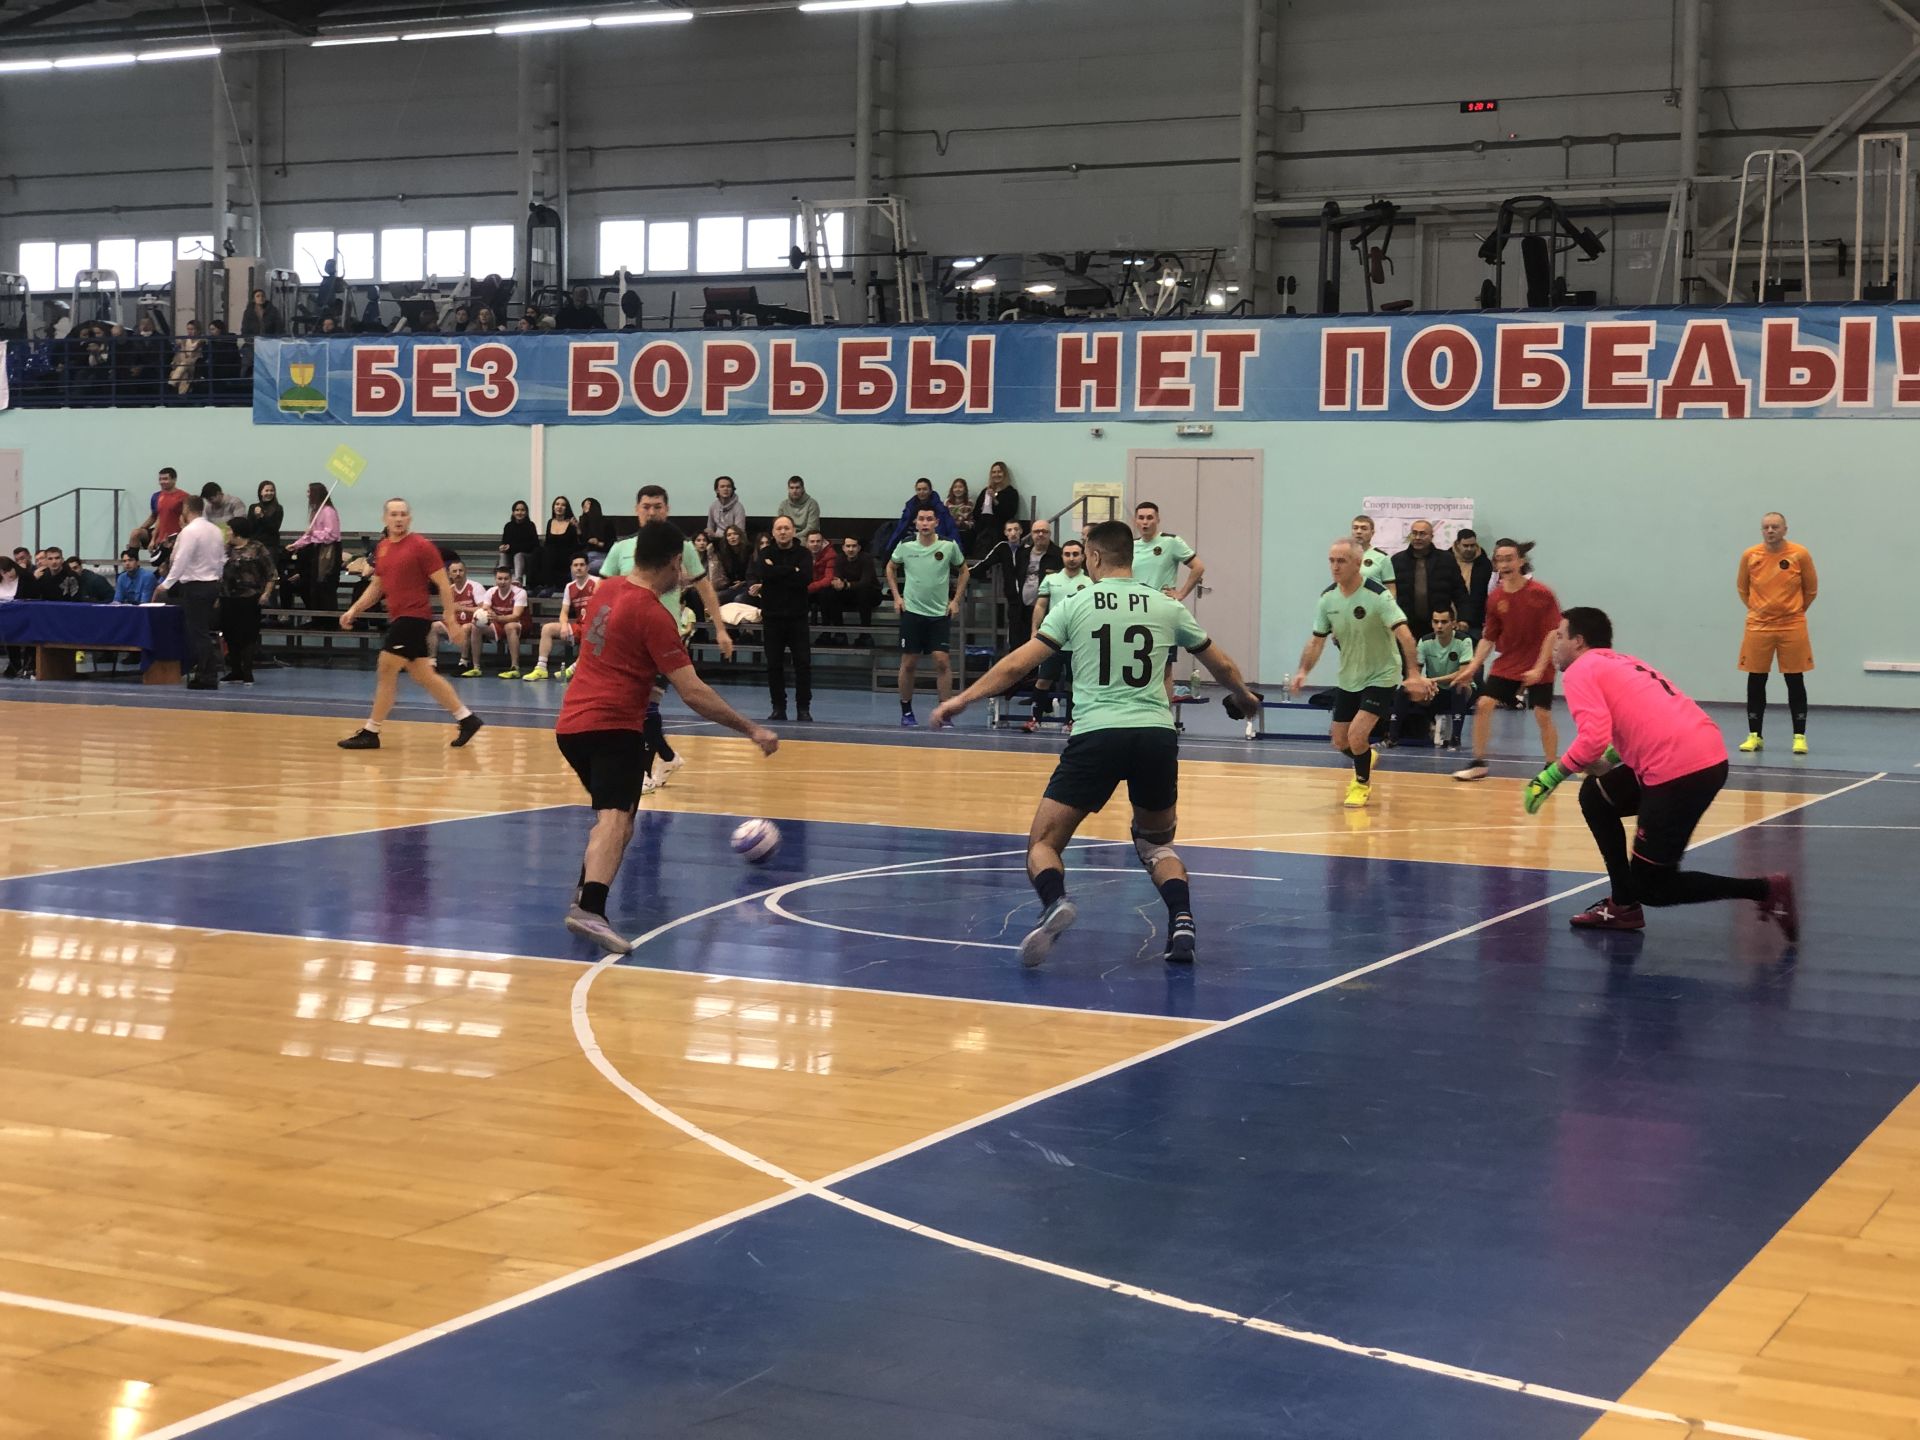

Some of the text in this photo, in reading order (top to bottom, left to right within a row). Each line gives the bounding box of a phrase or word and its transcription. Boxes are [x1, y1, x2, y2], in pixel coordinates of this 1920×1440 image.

[352, 315, 1920, 419] БЕЗ БОРЬБЫ НЕТ ПОБЕДЫ!
[1363, 500, 1390, 510] Спорт
[1091, 623, 1154, 688] 13
